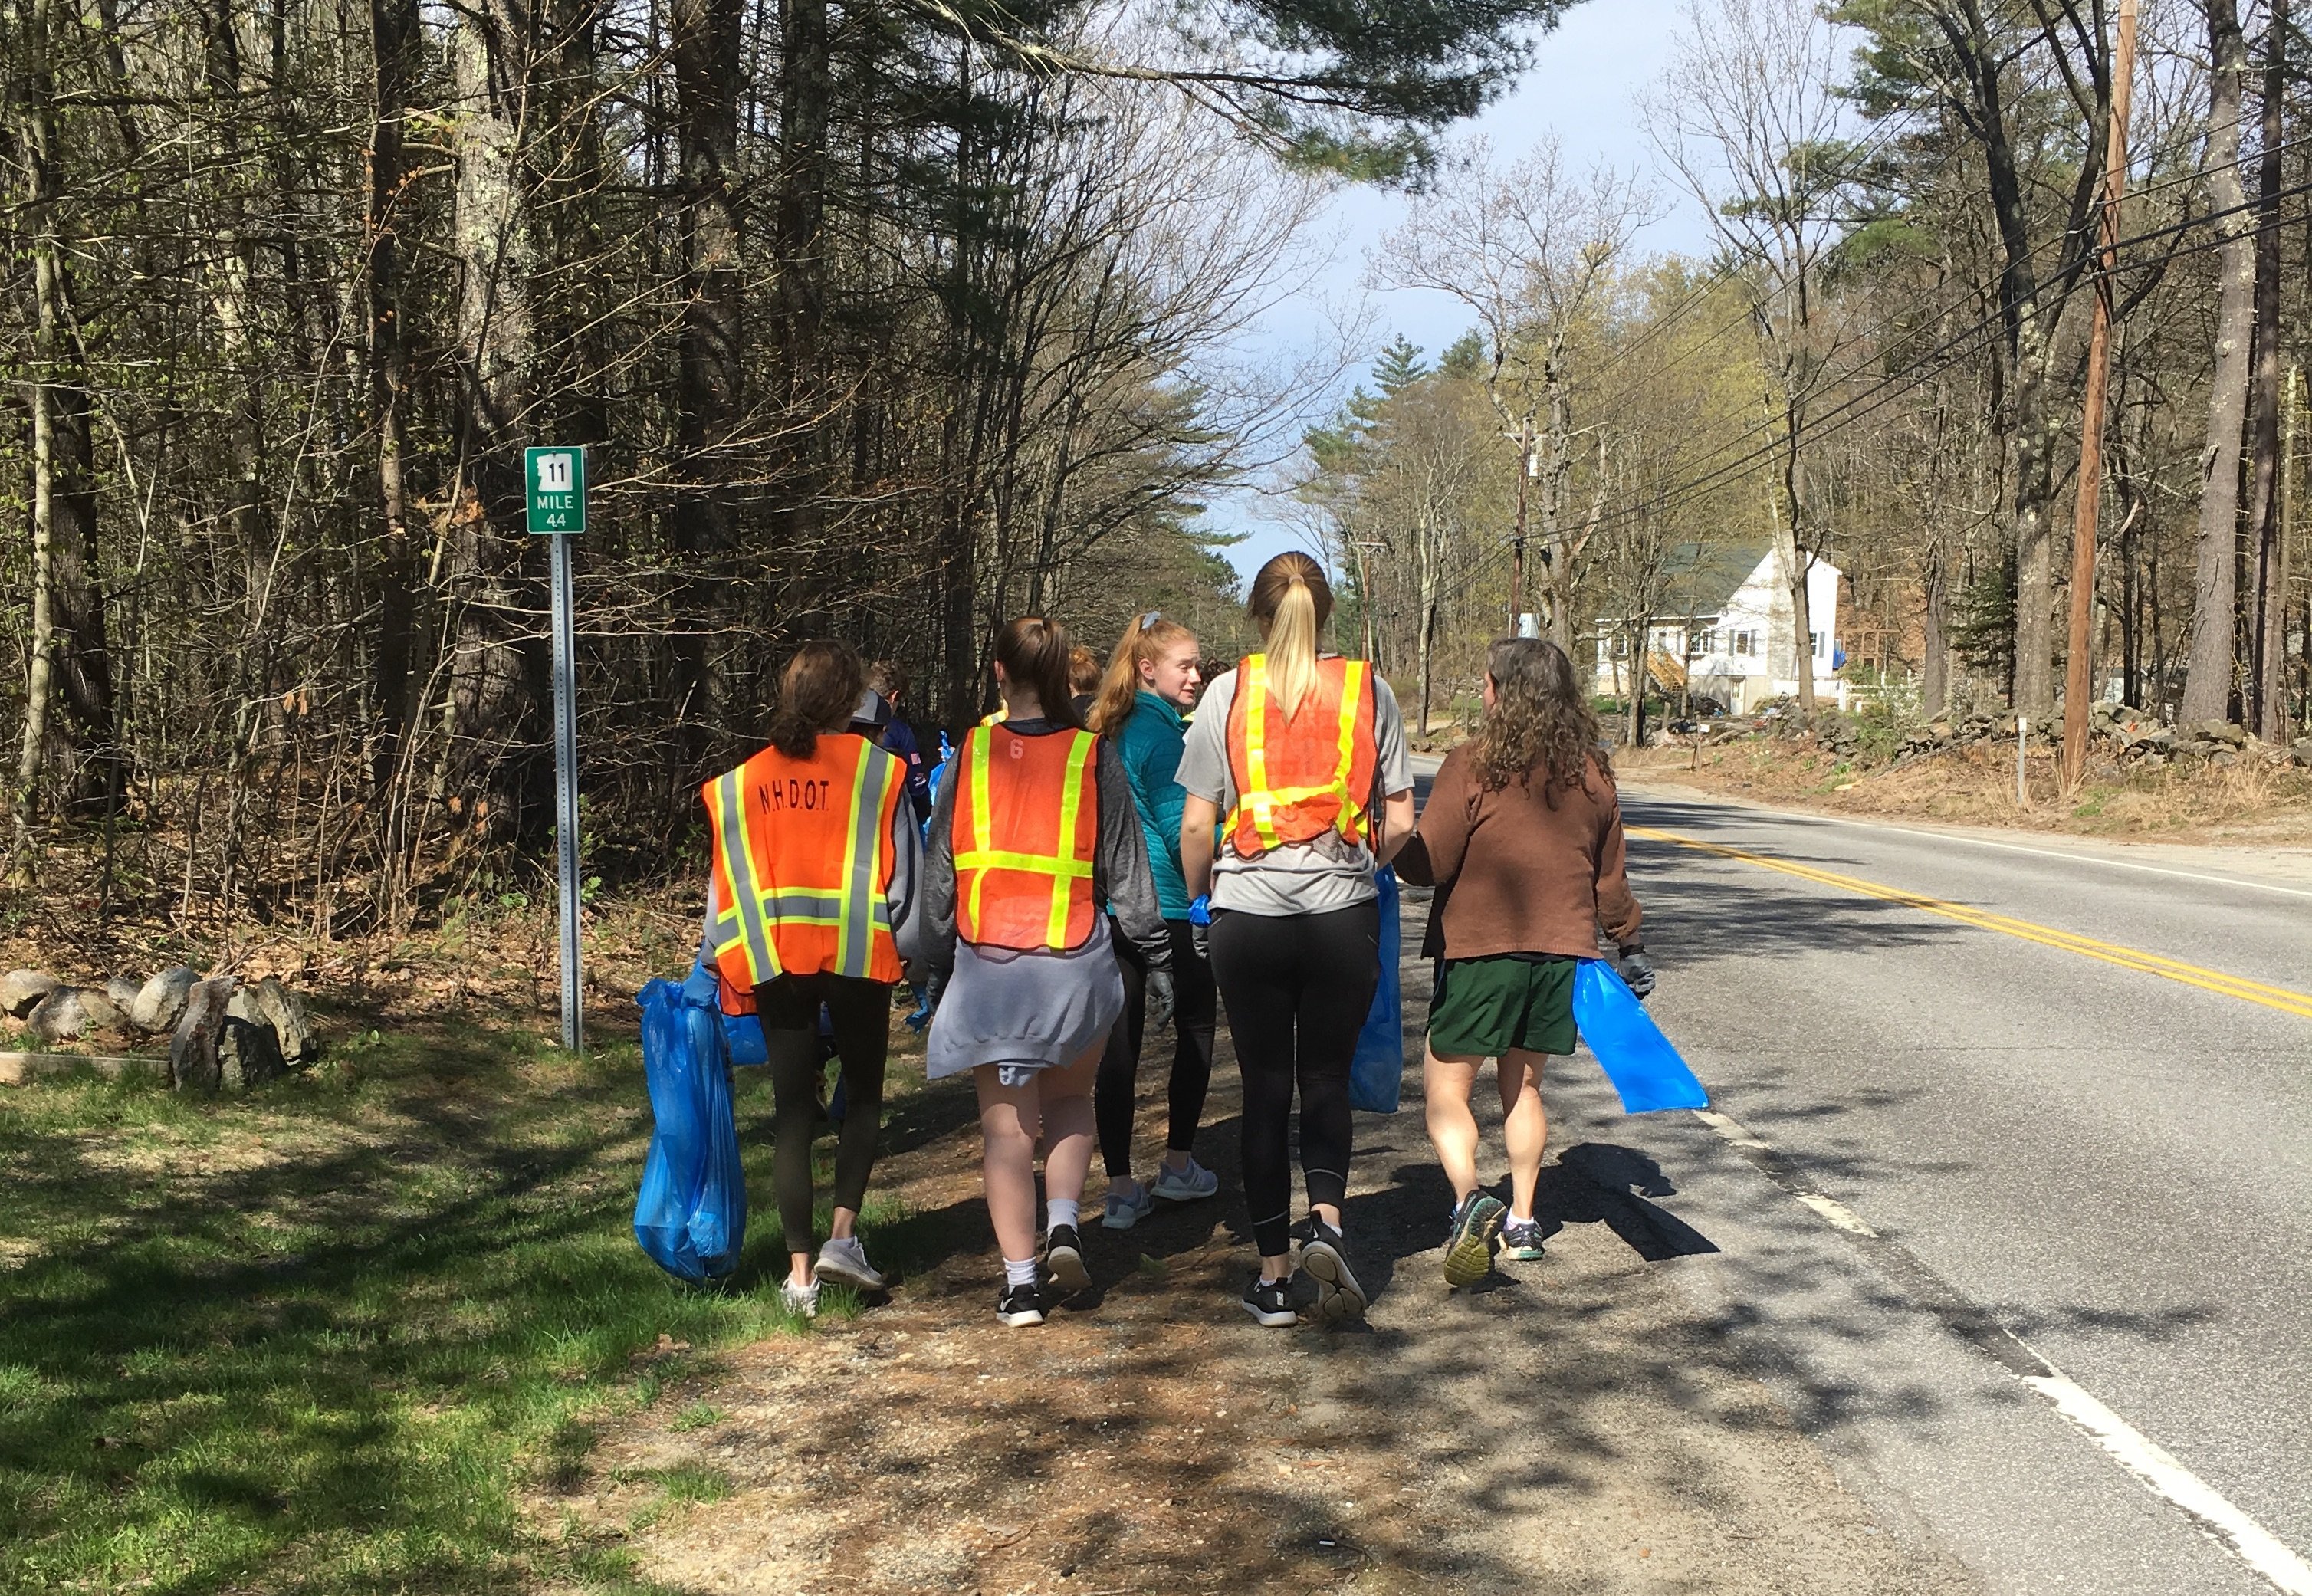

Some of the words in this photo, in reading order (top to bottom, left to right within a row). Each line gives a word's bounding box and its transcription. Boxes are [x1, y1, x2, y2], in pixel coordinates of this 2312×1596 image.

[549, 463, 564, 482] 11
[537, 495, 573, 510] MILE
[546, 513, 566, 527] 44
[1010, 738, 1023, 759] 6
